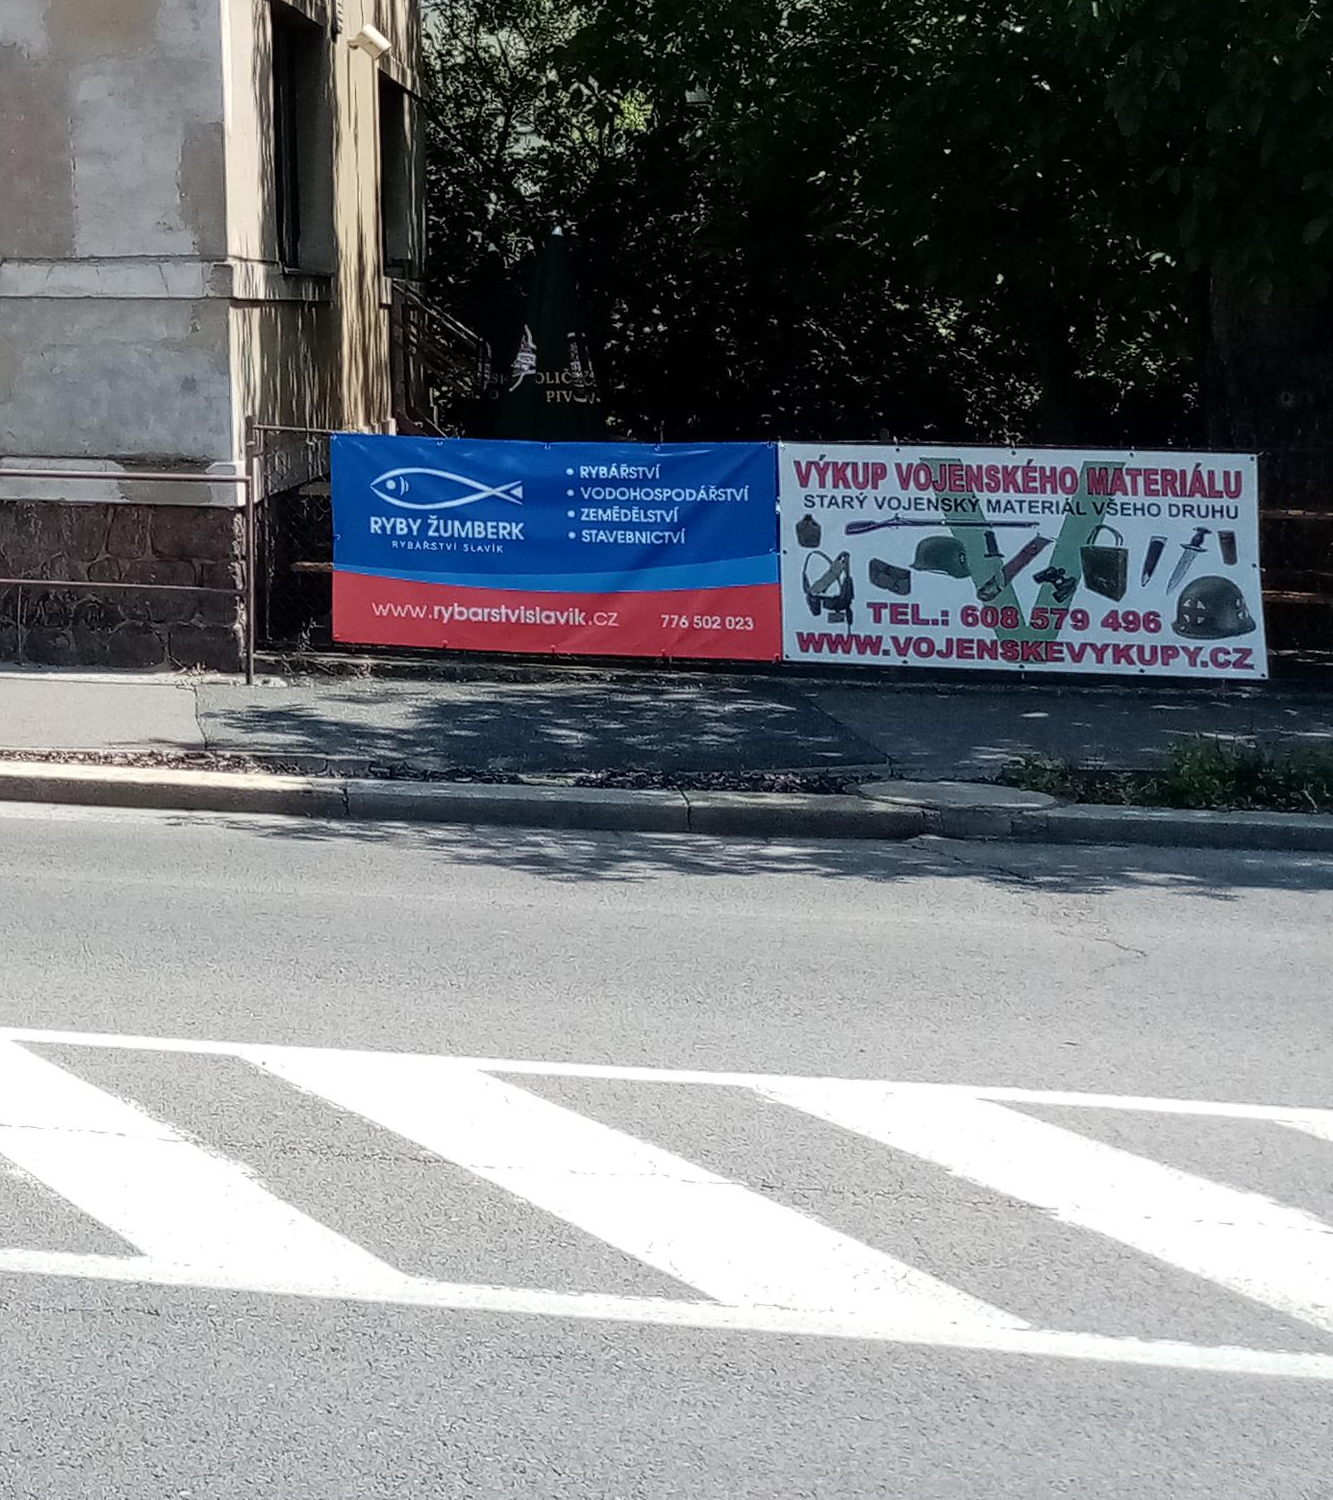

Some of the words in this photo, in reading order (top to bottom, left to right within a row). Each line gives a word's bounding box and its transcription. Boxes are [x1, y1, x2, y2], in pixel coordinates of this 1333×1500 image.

[579, 463, 660, 481] RYBÁŘSTVÍ
[793, 454, 888, 491] VÝKUP
[895, 458, 1079, 495] VOJENSKÉHO
[1086, 462, 1243, 499] MATERIÁLU
[580, 484, 749, 503] VODOHOSPODÁŘSTVÍ
[580, 505, 679, 524] ZEMĚDĚLSTVÍ
[803, 492, 868, 510] STARÝ
[874, 495, 980, 514] VOJENSKÝ
[986, 498, 1087, 516] MATERIÁL
[1092, 499, 1162, 518] VŠEHO
[1168, 502, 1239, 520] DRUHU
[370, 515, 422, 536] RYBY
[427, 514, 525, 541] ŽUMBERK
[581, 527, 686, 545] STAVEBNICTVÍ
[463, 542, 504, 554] SLAVÍK
[371, 601, 620, 628] www.rybarstvislavik.cz
[661, 614, 690, 629] 776
[693, 615, 722, 630] 502
[725, 616, 754, 631] 023
[866, 602, 950, 627] TEL.:
[960, 605, 1020, 630] 608
[1030, 607, 1090, 632] 579
[1100, 609, 1163, 634] 496
[795, 631, 1255, 671] WWW.VOJENSKEVYKUPY.CZ
